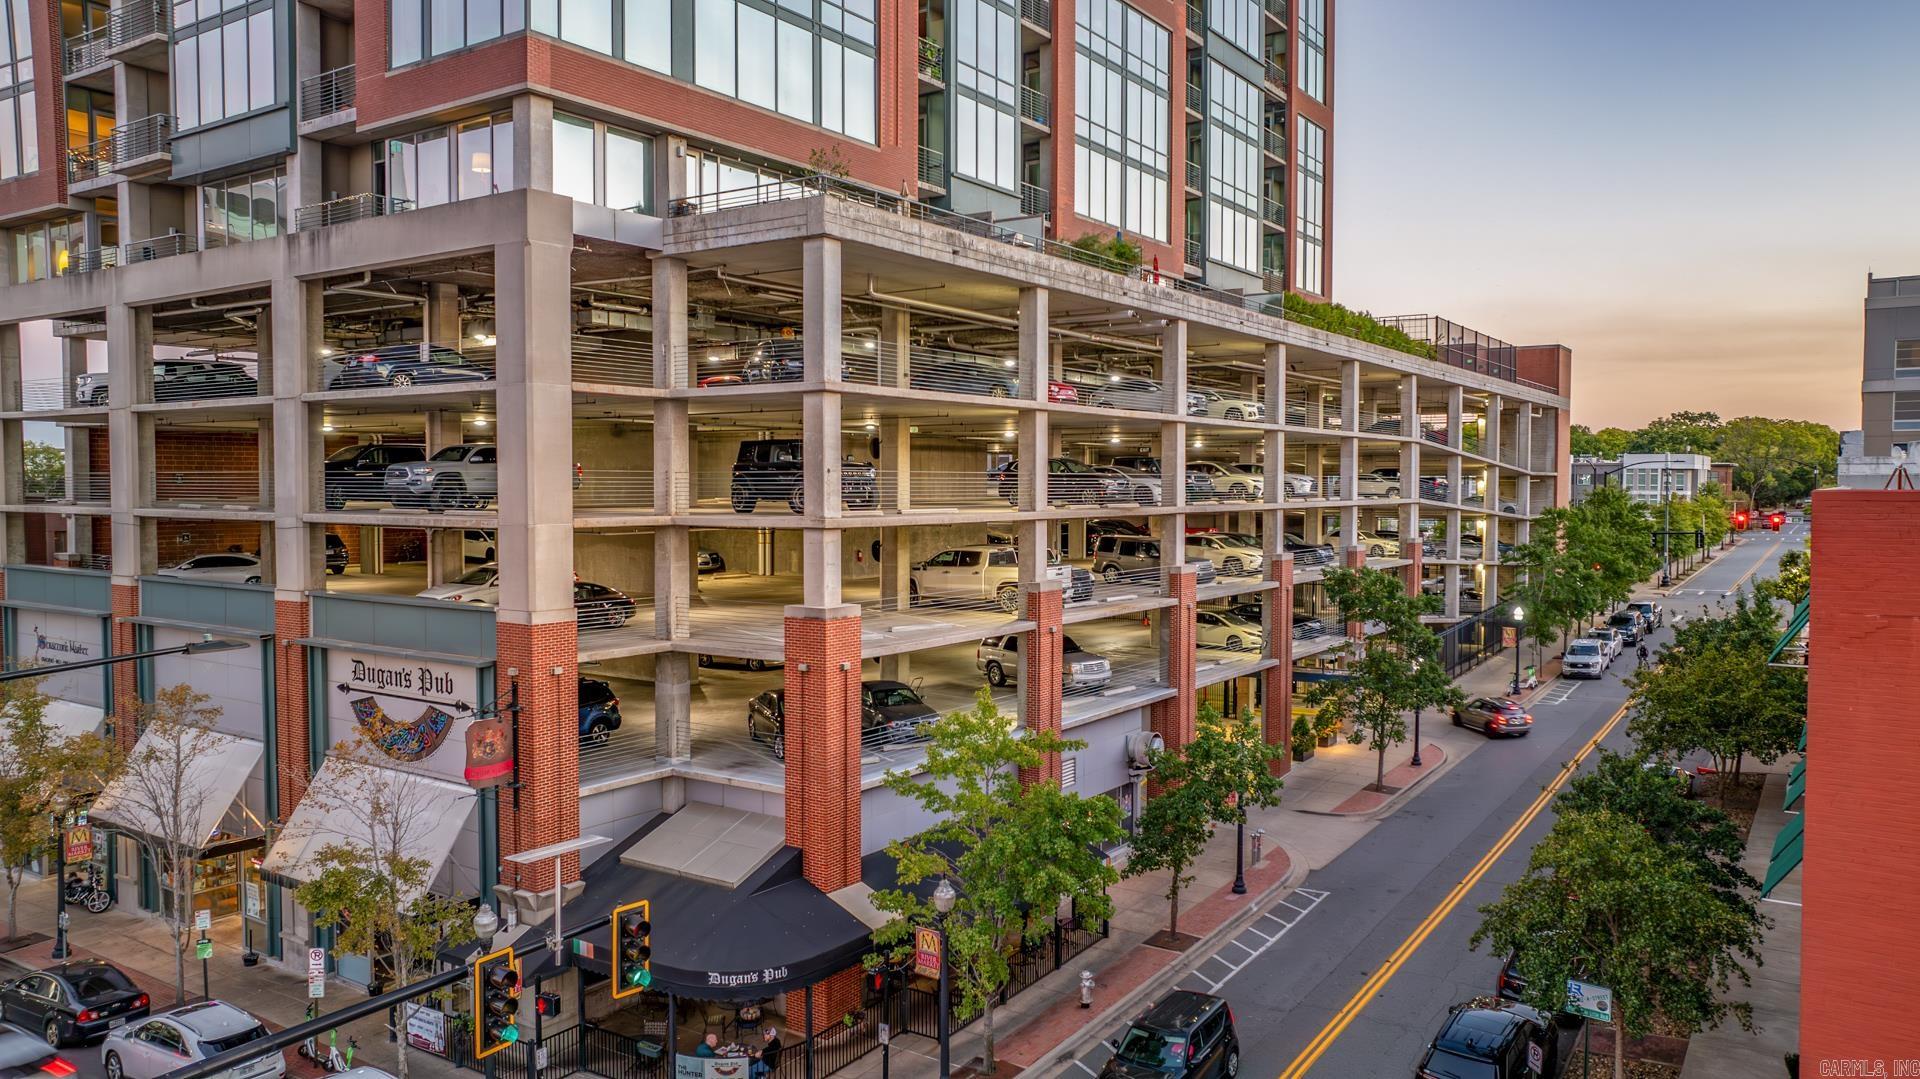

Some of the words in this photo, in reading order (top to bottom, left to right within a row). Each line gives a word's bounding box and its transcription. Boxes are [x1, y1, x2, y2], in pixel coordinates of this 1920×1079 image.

[352, 659, 412, 689] Dugan's
[418, 668, 453, 696] Pub
[708, 972, 758, 986] Dugan's
[763, 966, 787, 983] Pub
[677, 1069, 703, 1078] HUNTER
